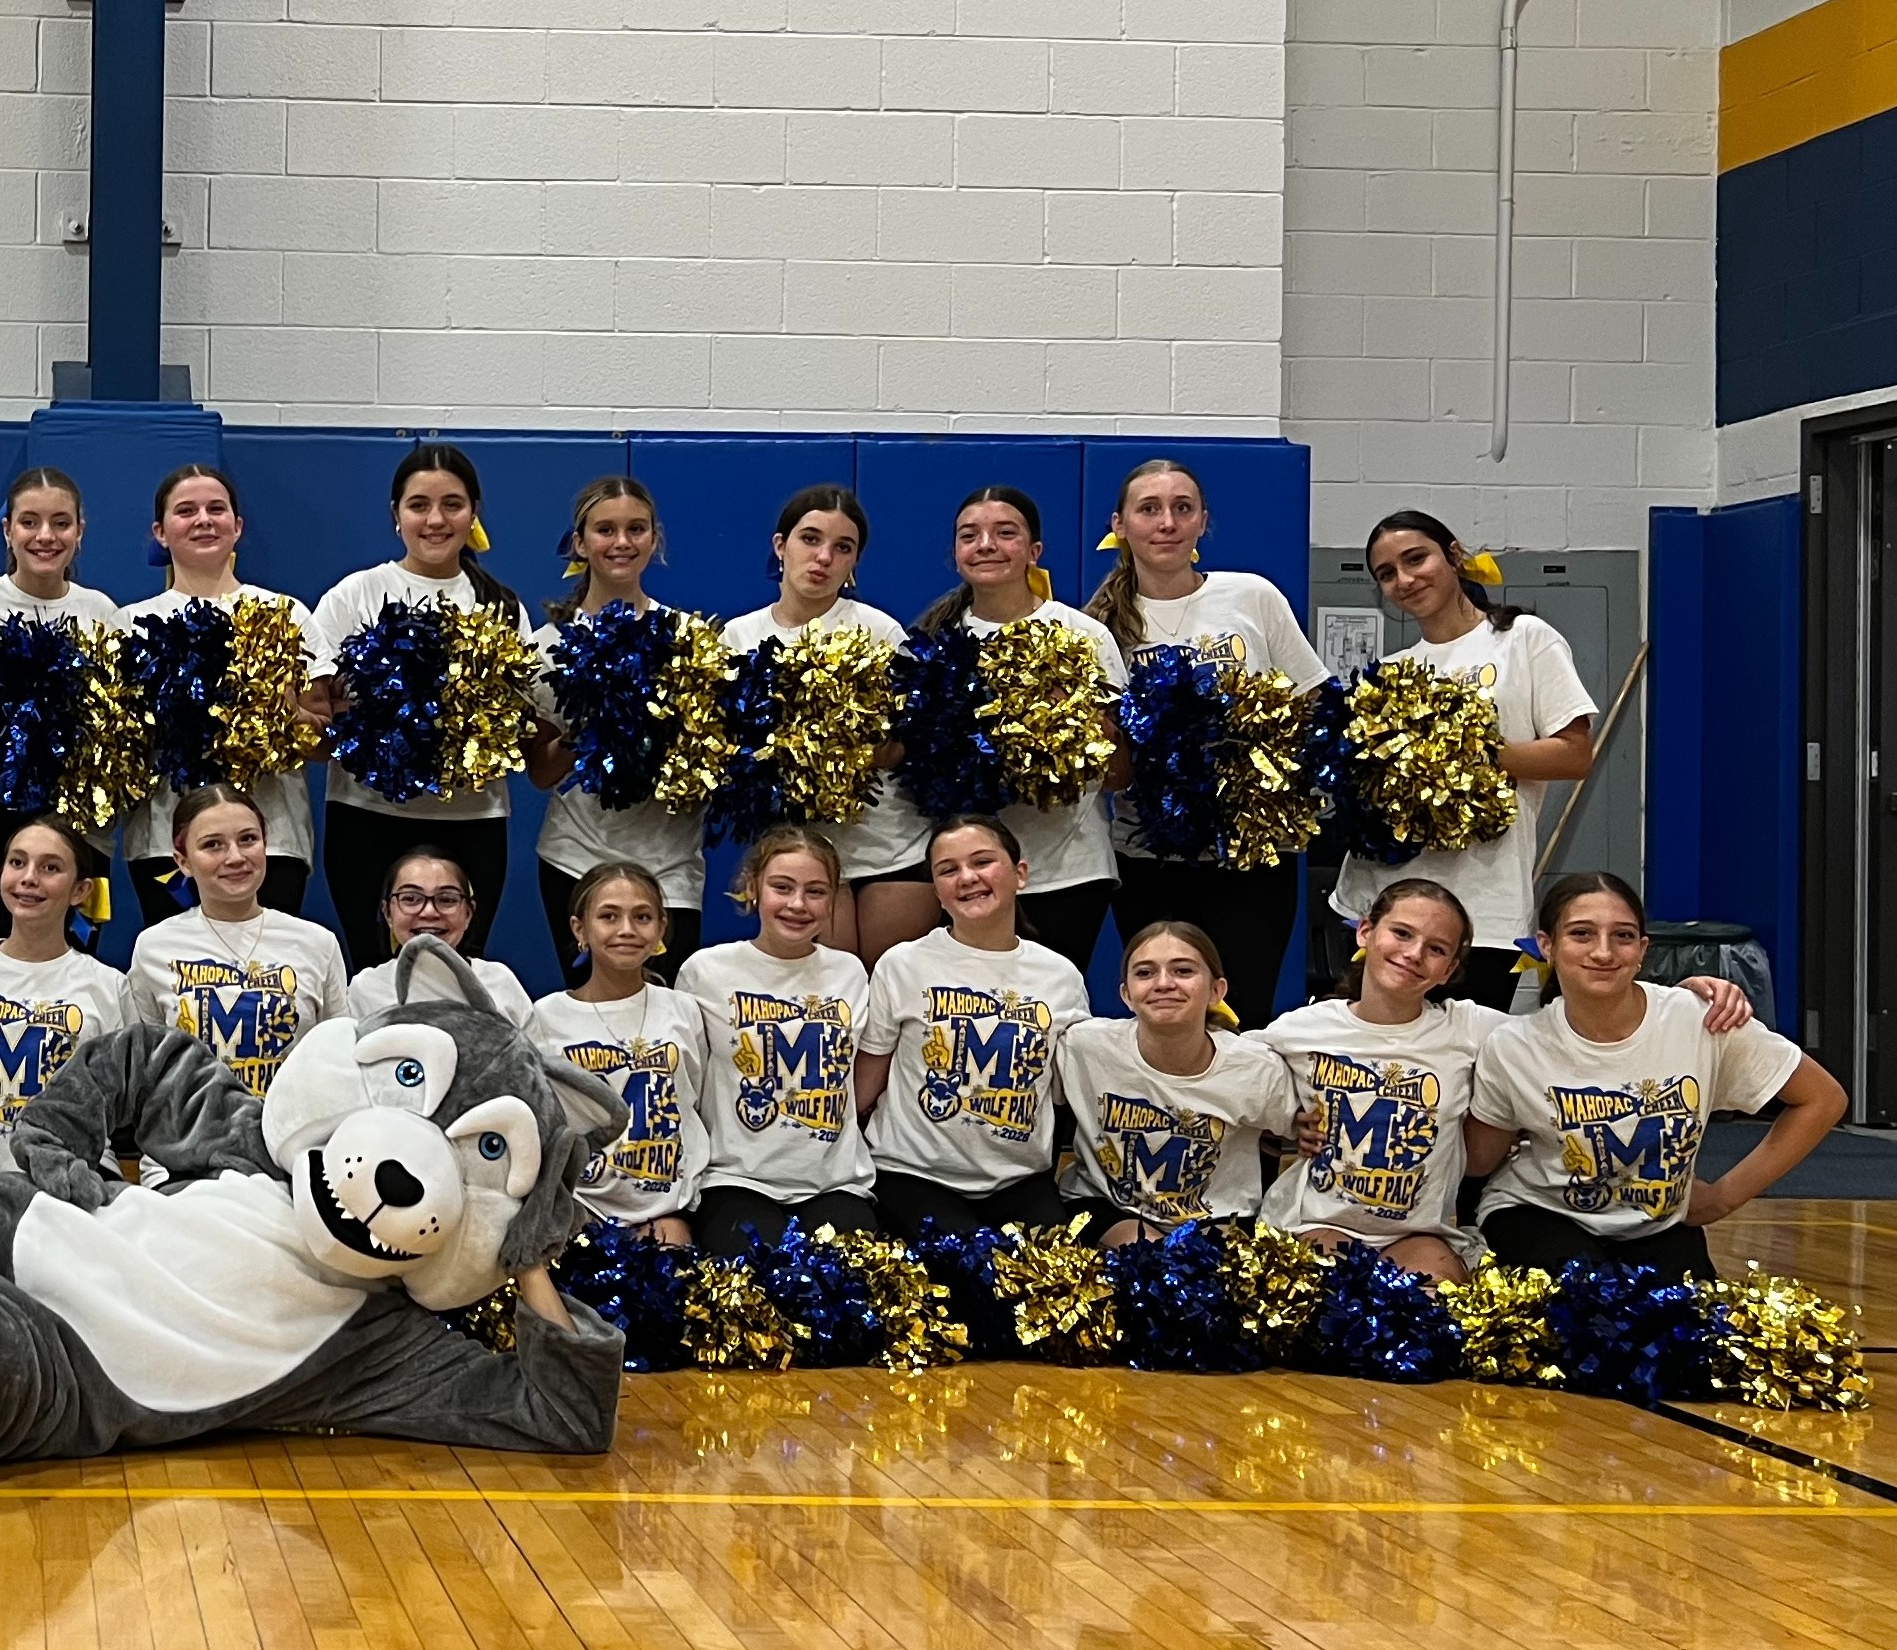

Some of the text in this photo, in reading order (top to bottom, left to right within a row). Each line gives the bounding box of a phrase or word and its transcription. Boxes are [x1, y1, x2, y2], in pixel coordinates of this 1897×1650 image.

[180, 962, 240, 988] MAHOPAC
[34, 1010, 63, 1025] CHEER
[740, 996, 800, 1023] MAHOPAC
[936, 990, 996, 1016] MAHOPAC
[1004, 1006, 1036, 1023] CHEER
[194, 987, 264, 1058] M
[756, 1021, 826, 1091] M
[946, 1017, 1021, 1088] M
[1317, 1058, 1375, 1089] MAHOPAC
[1382, 1081, 1420, 1100] CHEER
[1643, 1090, 1684, 1115] CHEER
[785, 1097, 821, 1120] WOLF
[969, 1093, 1034, 1127] WOLF PAC
[1107, 1099, 1170, 1129] MAHOPAC
[1560, 1092, 1634, 1123] MAHOPAC
[1000, 1127, 1031, 1143] 2026
[1324, 1089, 1400, 1170] M
[613, 1143, 673, 1176] WOLF PAC
[1118, 1131, 1192, 1193] M
[1583, 1115, 1667, 1181] M
[1342, 1173, 1413, 1207] WOLF PAC
[1619, 1187, 1662, 1208] WOLF
